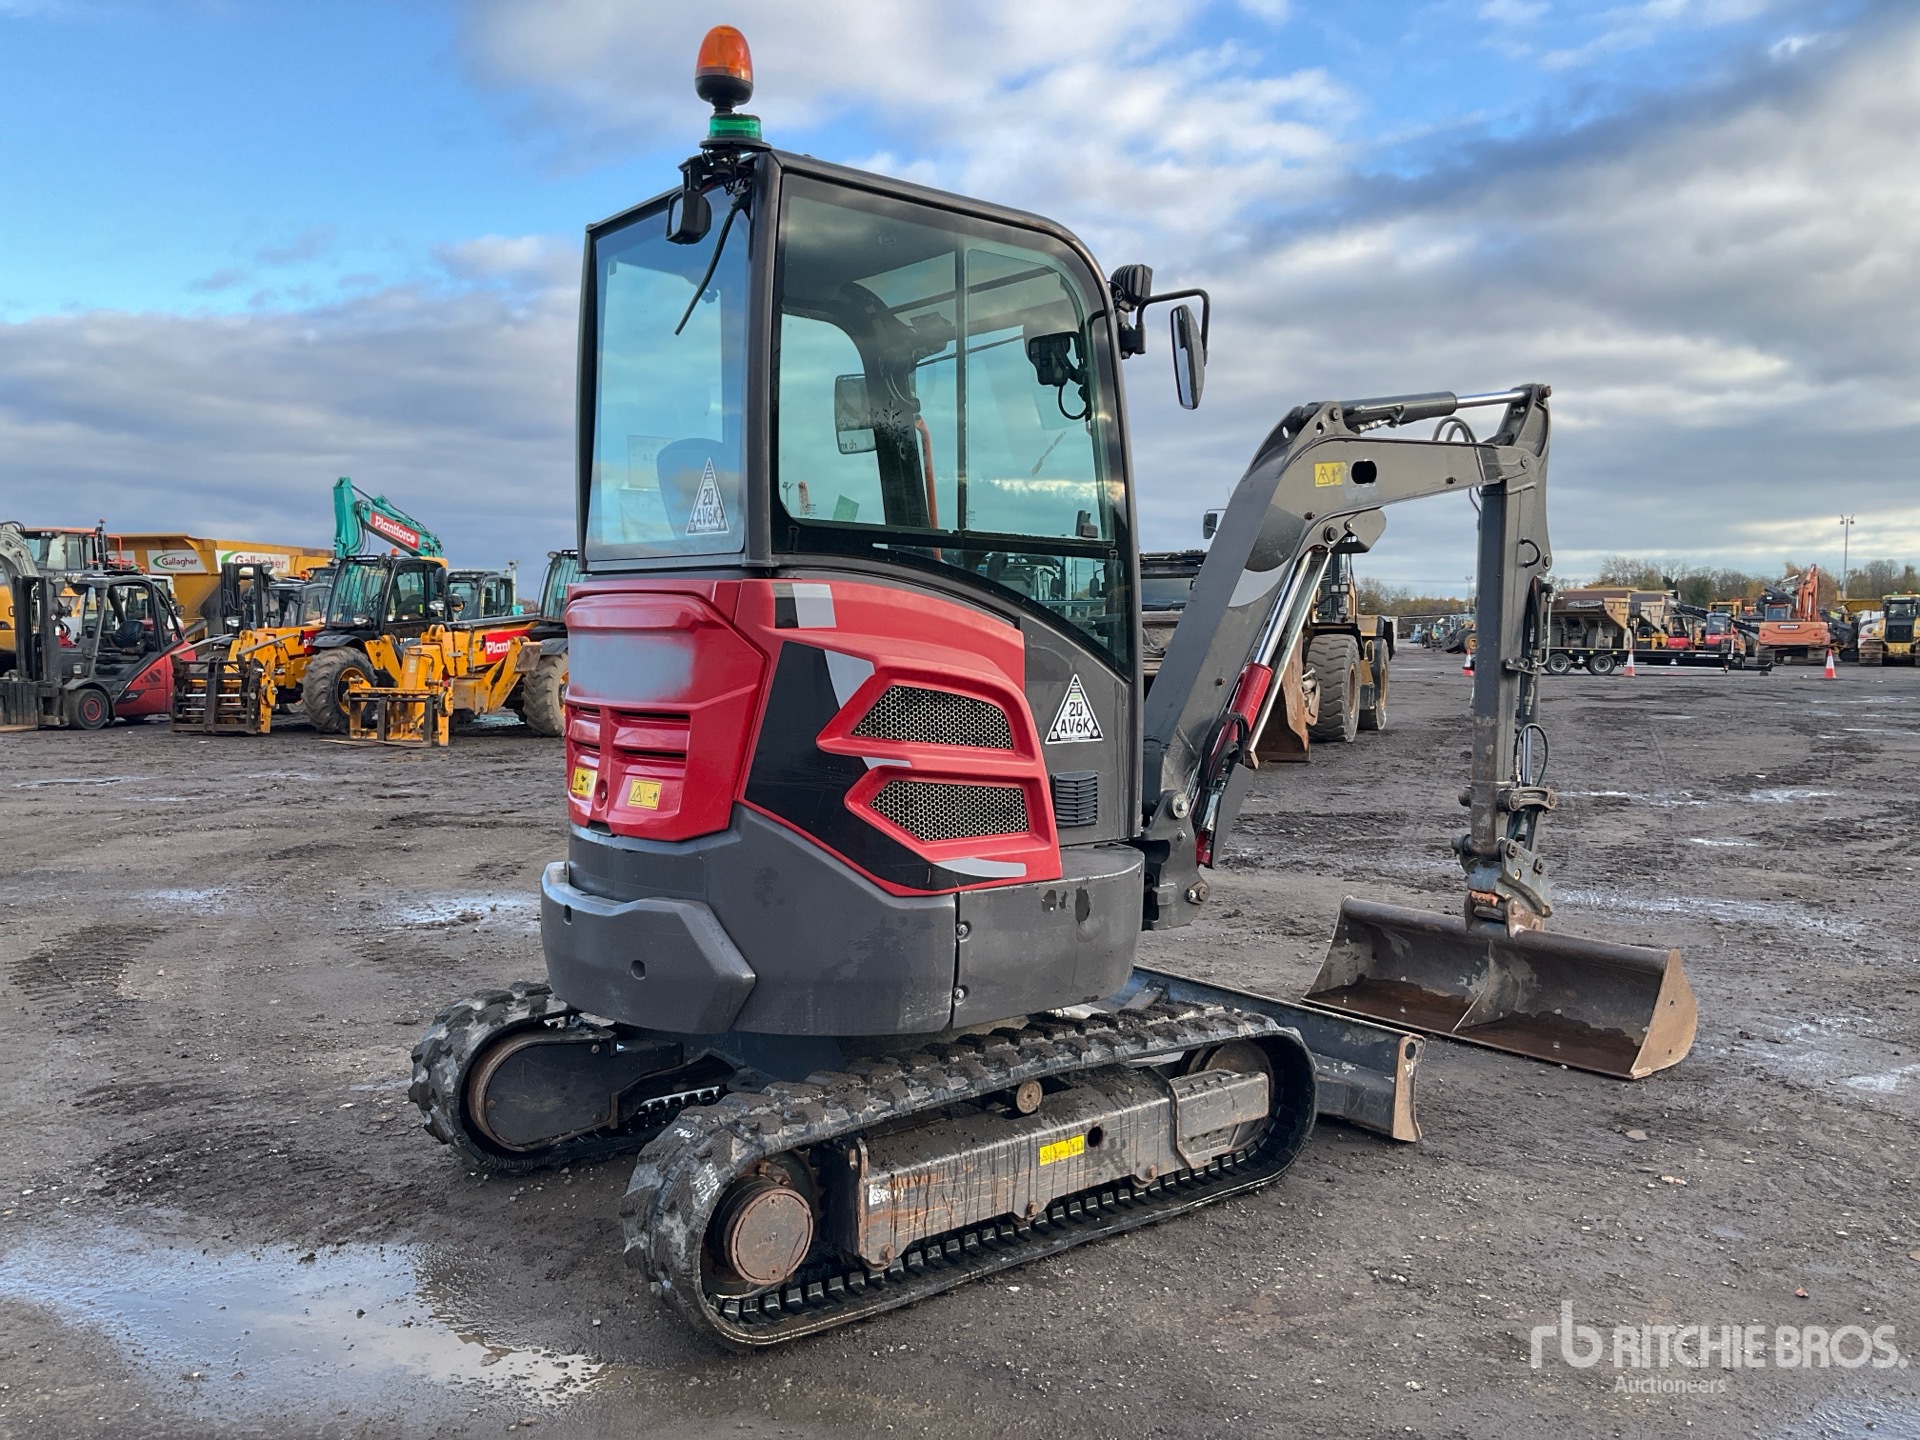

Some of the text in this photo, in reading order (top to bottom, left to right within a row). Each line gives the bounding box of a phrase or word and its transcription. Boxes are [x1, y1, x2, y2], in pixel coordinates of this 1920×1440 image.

[703, 488, 713, 506] 20
[696, 507, 720, 525] AV6K
[375, 515, 416, 544] Plantforce
[161, 557, 198, 567] Gallagher
[1069, 701, 1083, 717] 20
[1060, 717, 1091, 734] AV6K
